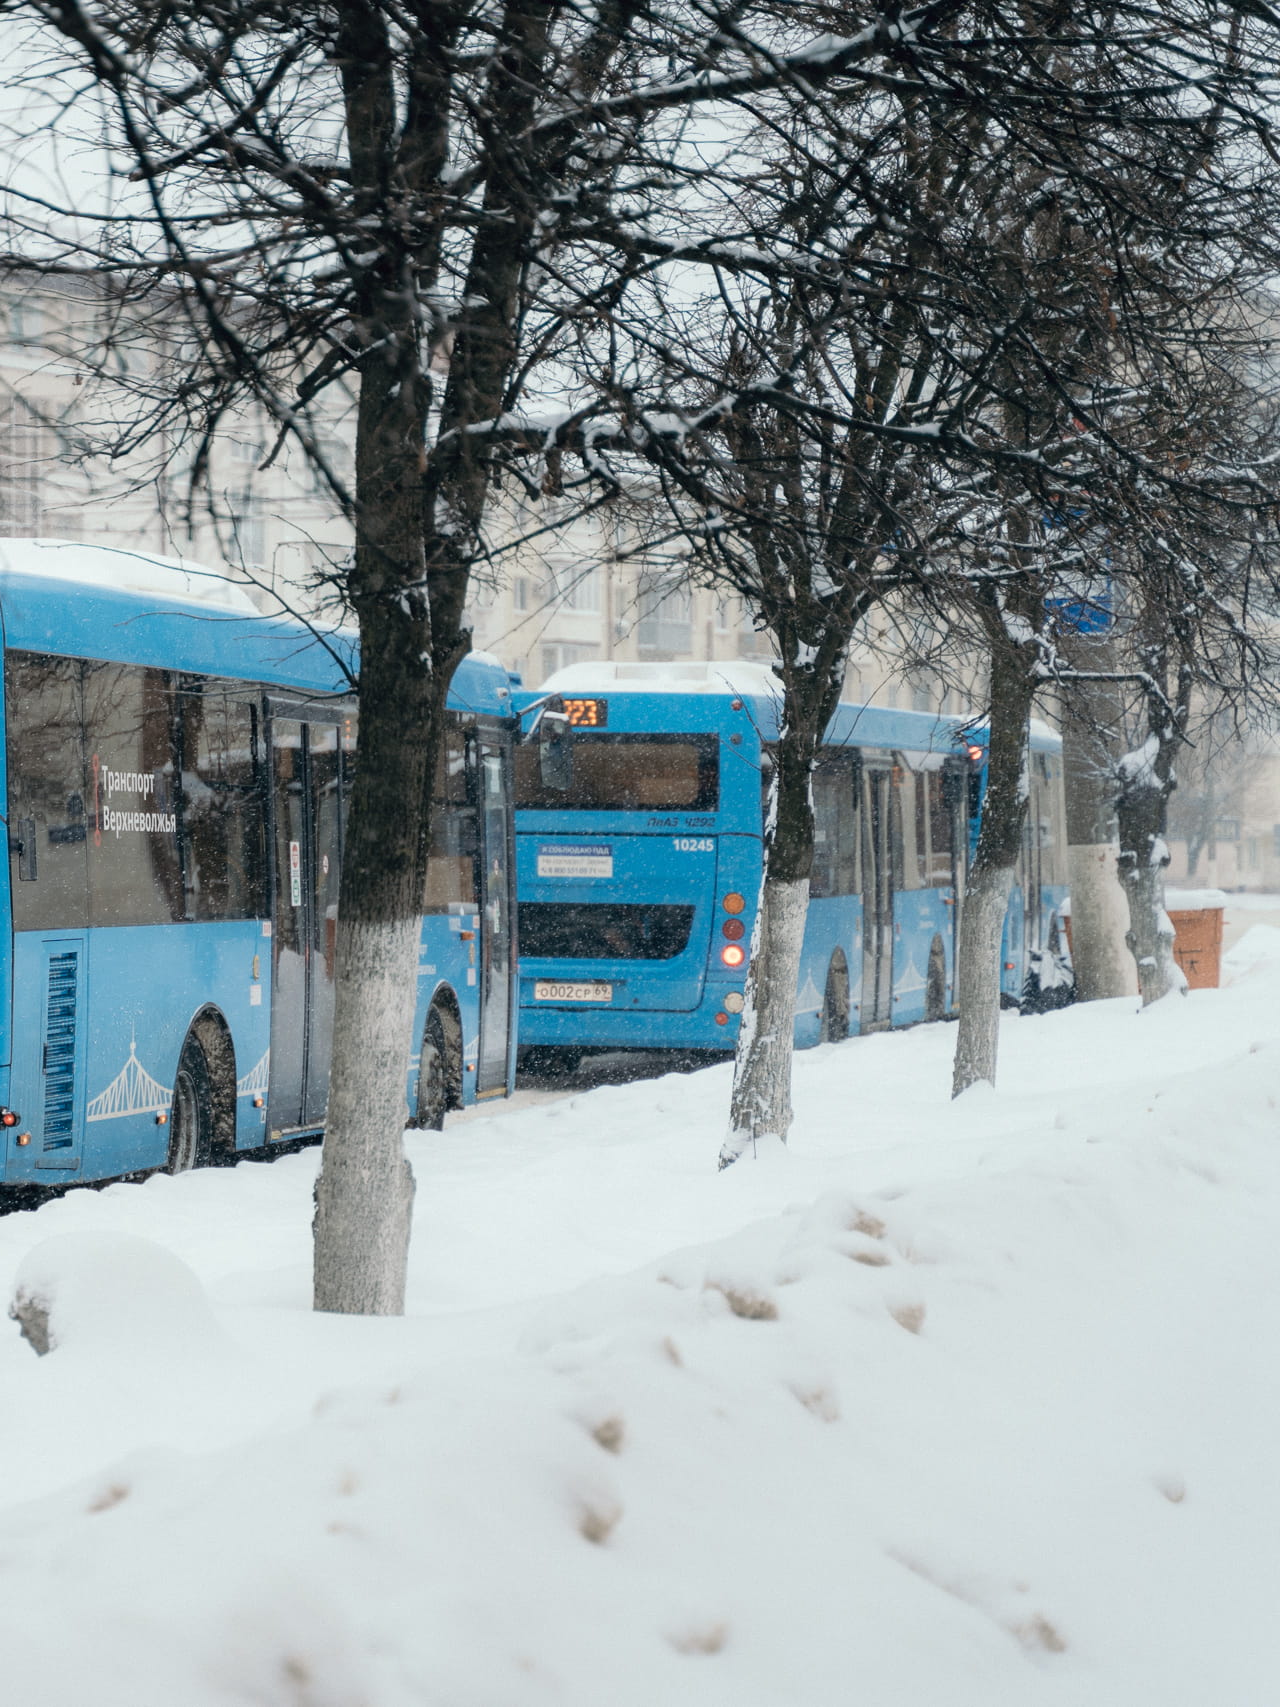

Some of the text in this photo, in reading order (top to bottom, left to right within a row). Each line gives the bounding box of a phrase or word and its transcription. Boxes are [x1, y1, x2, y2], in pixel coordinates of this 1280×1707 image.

[101, 765, 155, 800] Транспорт
[103, 805, 177, 839] Верхневолжья
[672, 839, 714, 852] 10245
[594, 986, 608, 996] 69
